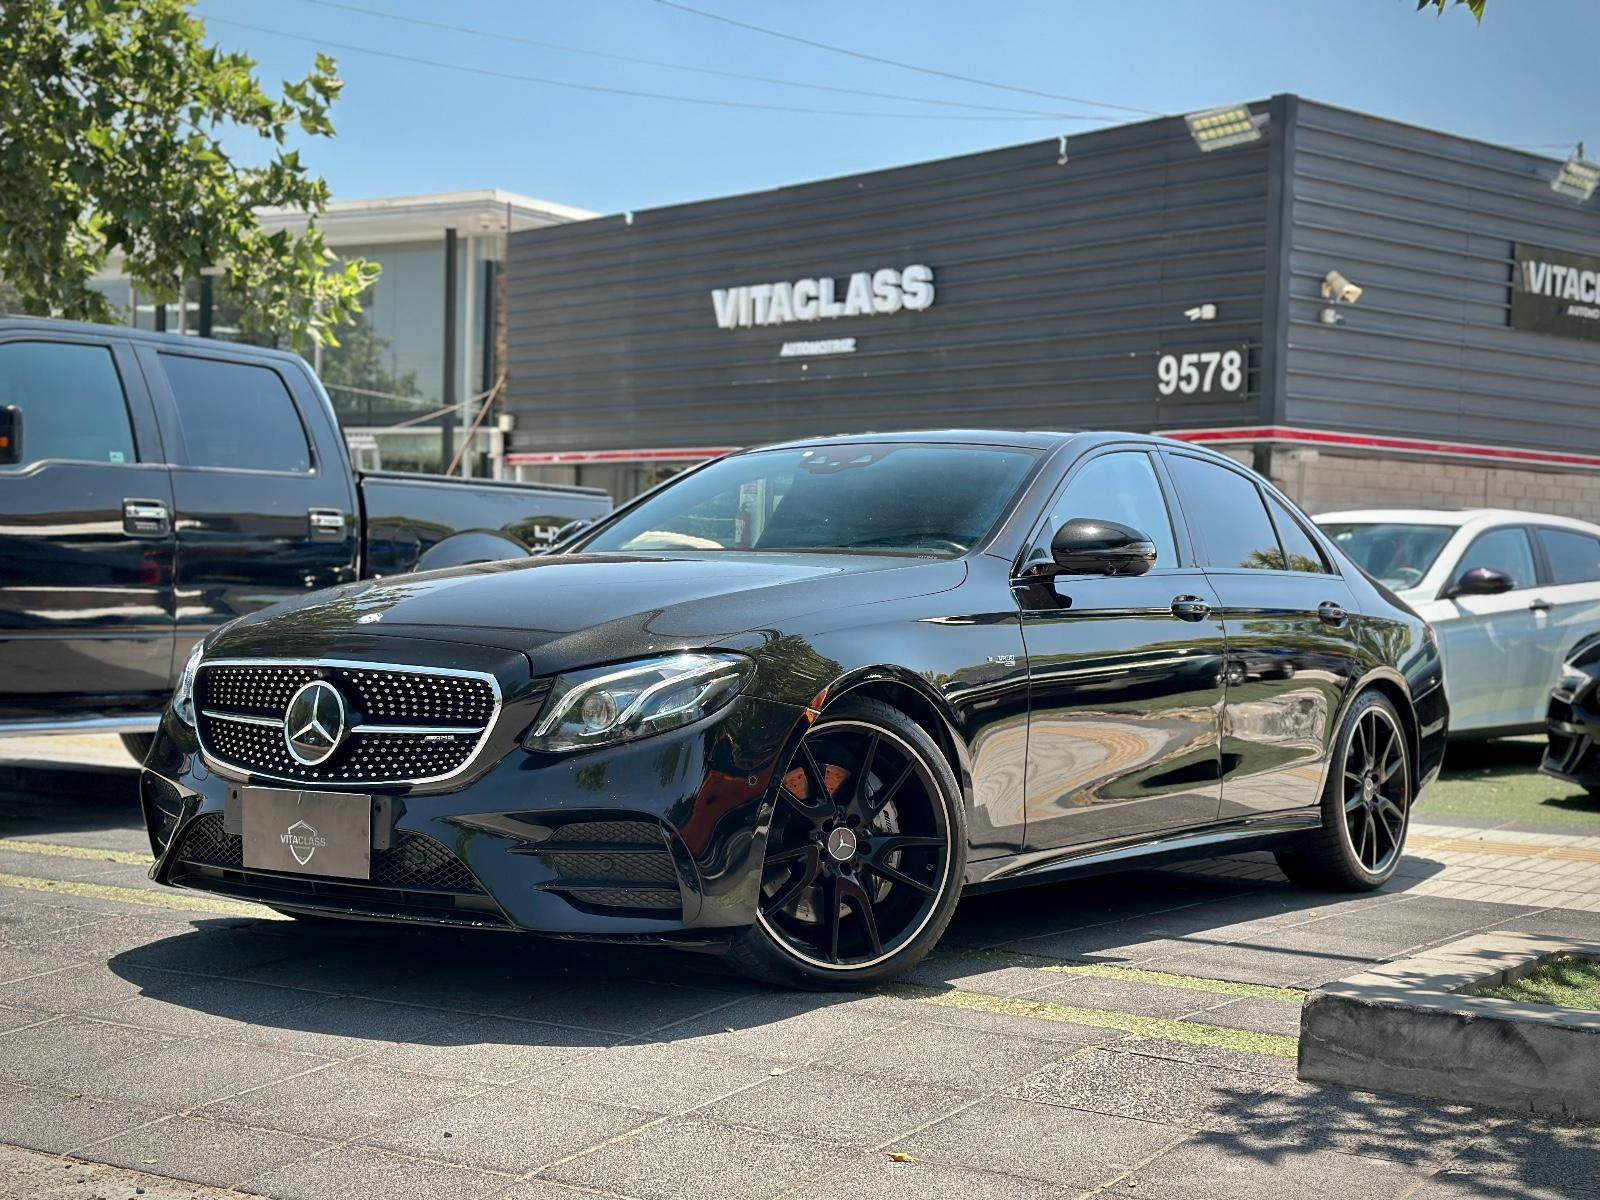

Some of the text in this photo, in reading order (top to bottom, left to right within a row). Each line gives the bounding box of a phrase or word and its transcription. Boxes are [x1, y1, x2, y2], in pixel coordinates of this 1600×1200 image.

[712, 264, 935, 329] VITACLASS
[1158, 350, 1242, 395] 9578
[280, 833, 326, 847] VITACLASS
